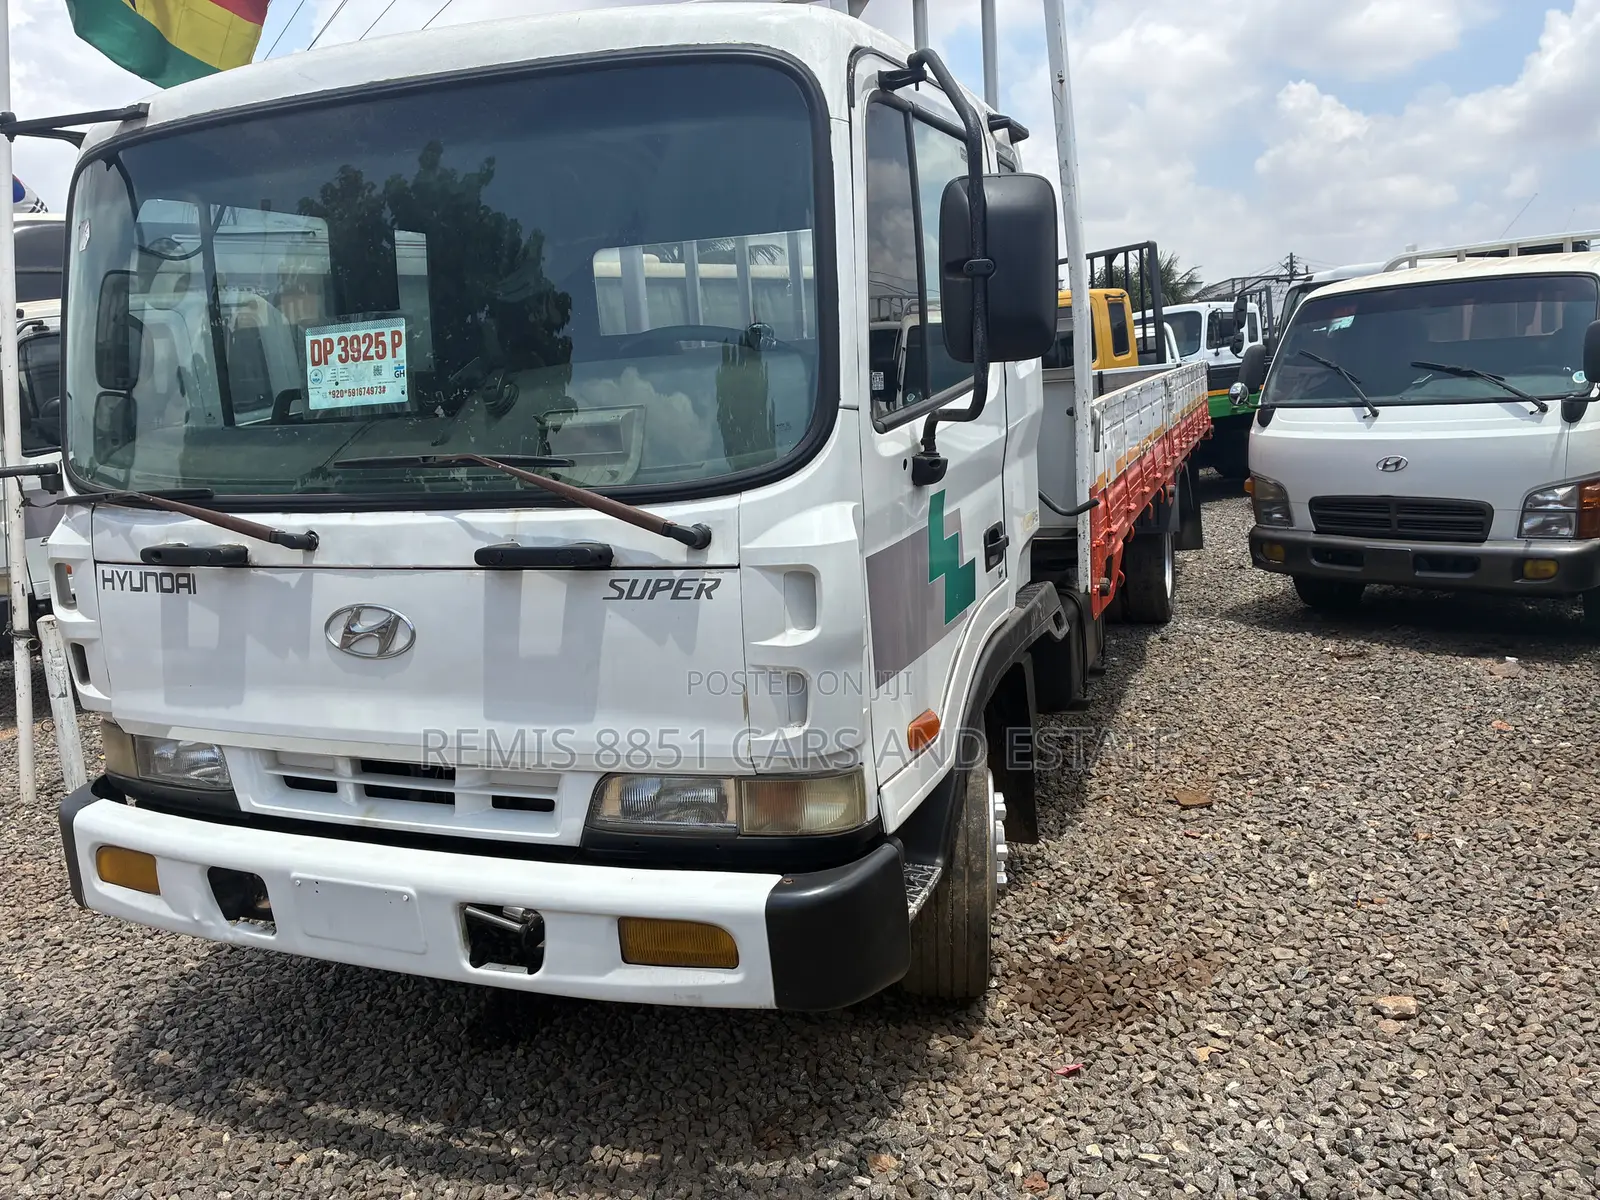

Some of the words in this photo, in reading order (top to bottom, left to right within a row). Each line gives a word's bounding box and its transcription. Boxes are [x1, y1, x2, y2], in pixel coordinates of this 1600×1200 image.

[309, 337, 335, 366] DP
[337, 331, 386, 363] 3925
[390, 329, 403, 358] P
[394, 369, 405, 378] GH
[101, 569, 197, 595] HYUNDAI
[602, 578, 722, 600] SUPER
